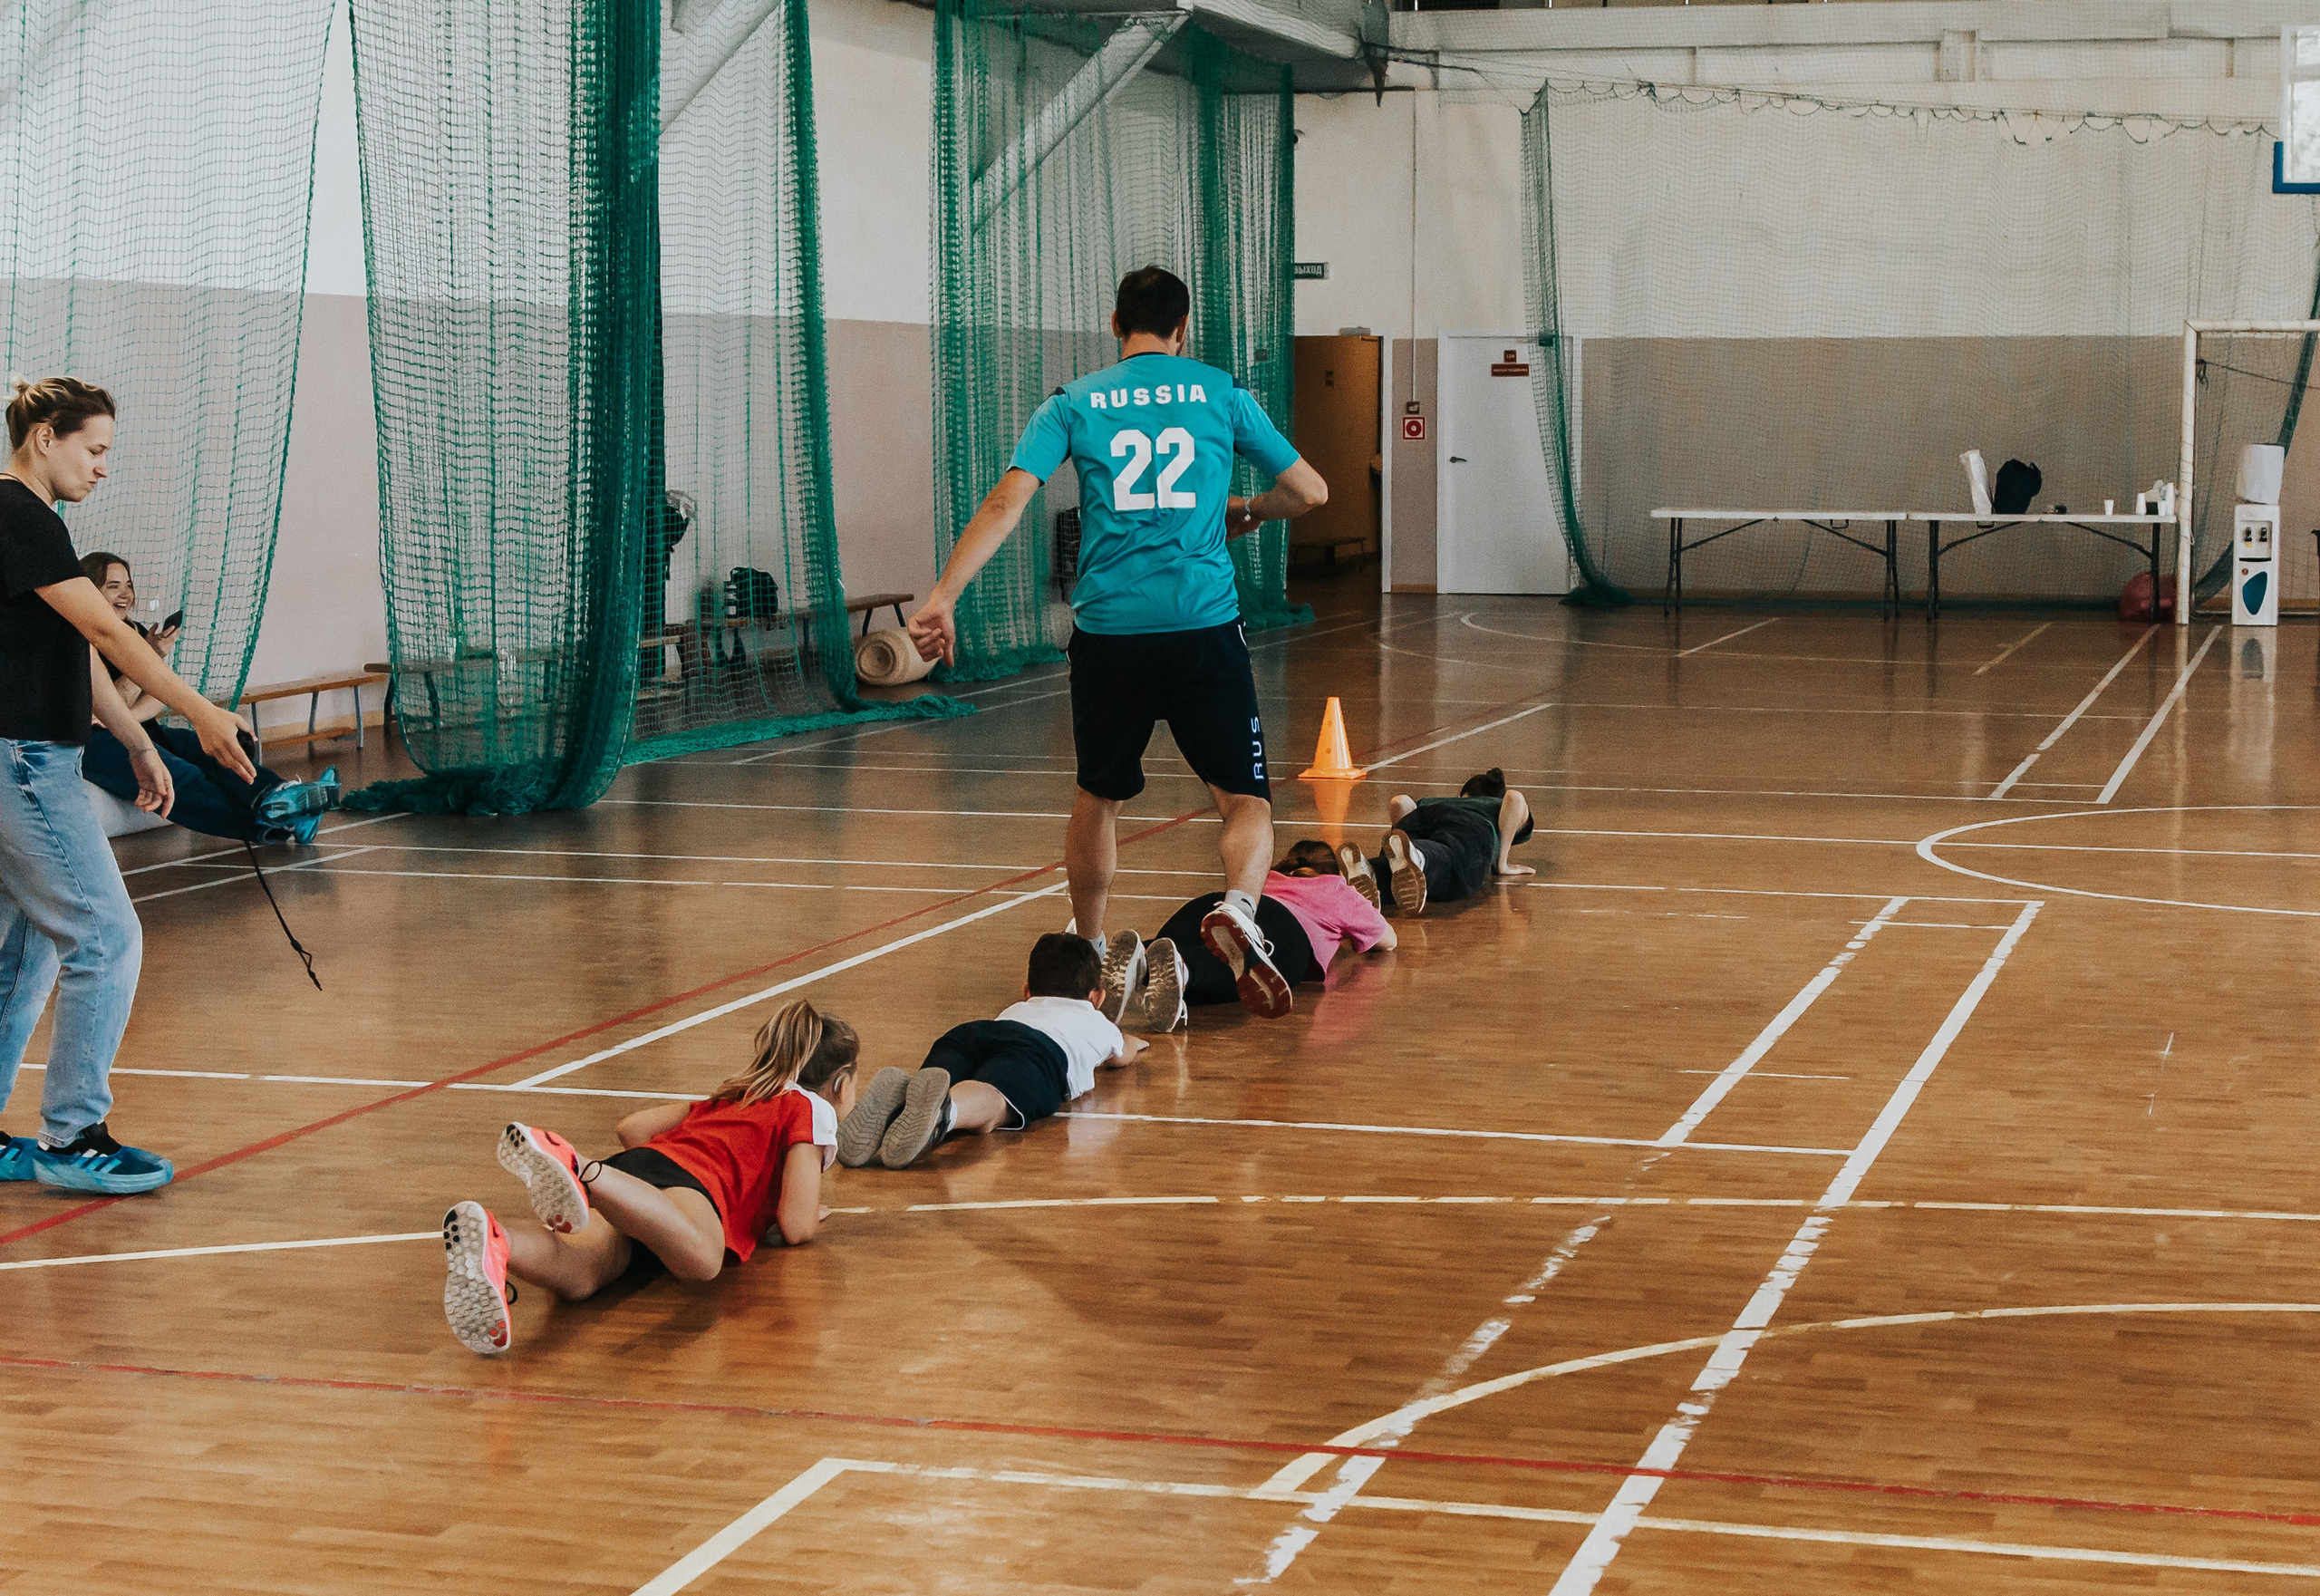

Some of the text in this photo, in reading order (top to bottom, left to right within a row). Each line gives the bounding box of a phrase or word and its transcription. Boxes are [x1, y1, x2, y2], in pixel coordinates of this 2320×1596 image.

[1090, 383, 1207, 409] RUSSIA
[1110, 427, 1196, 510] 22
[1251, 716, 1264, 779] RUS
